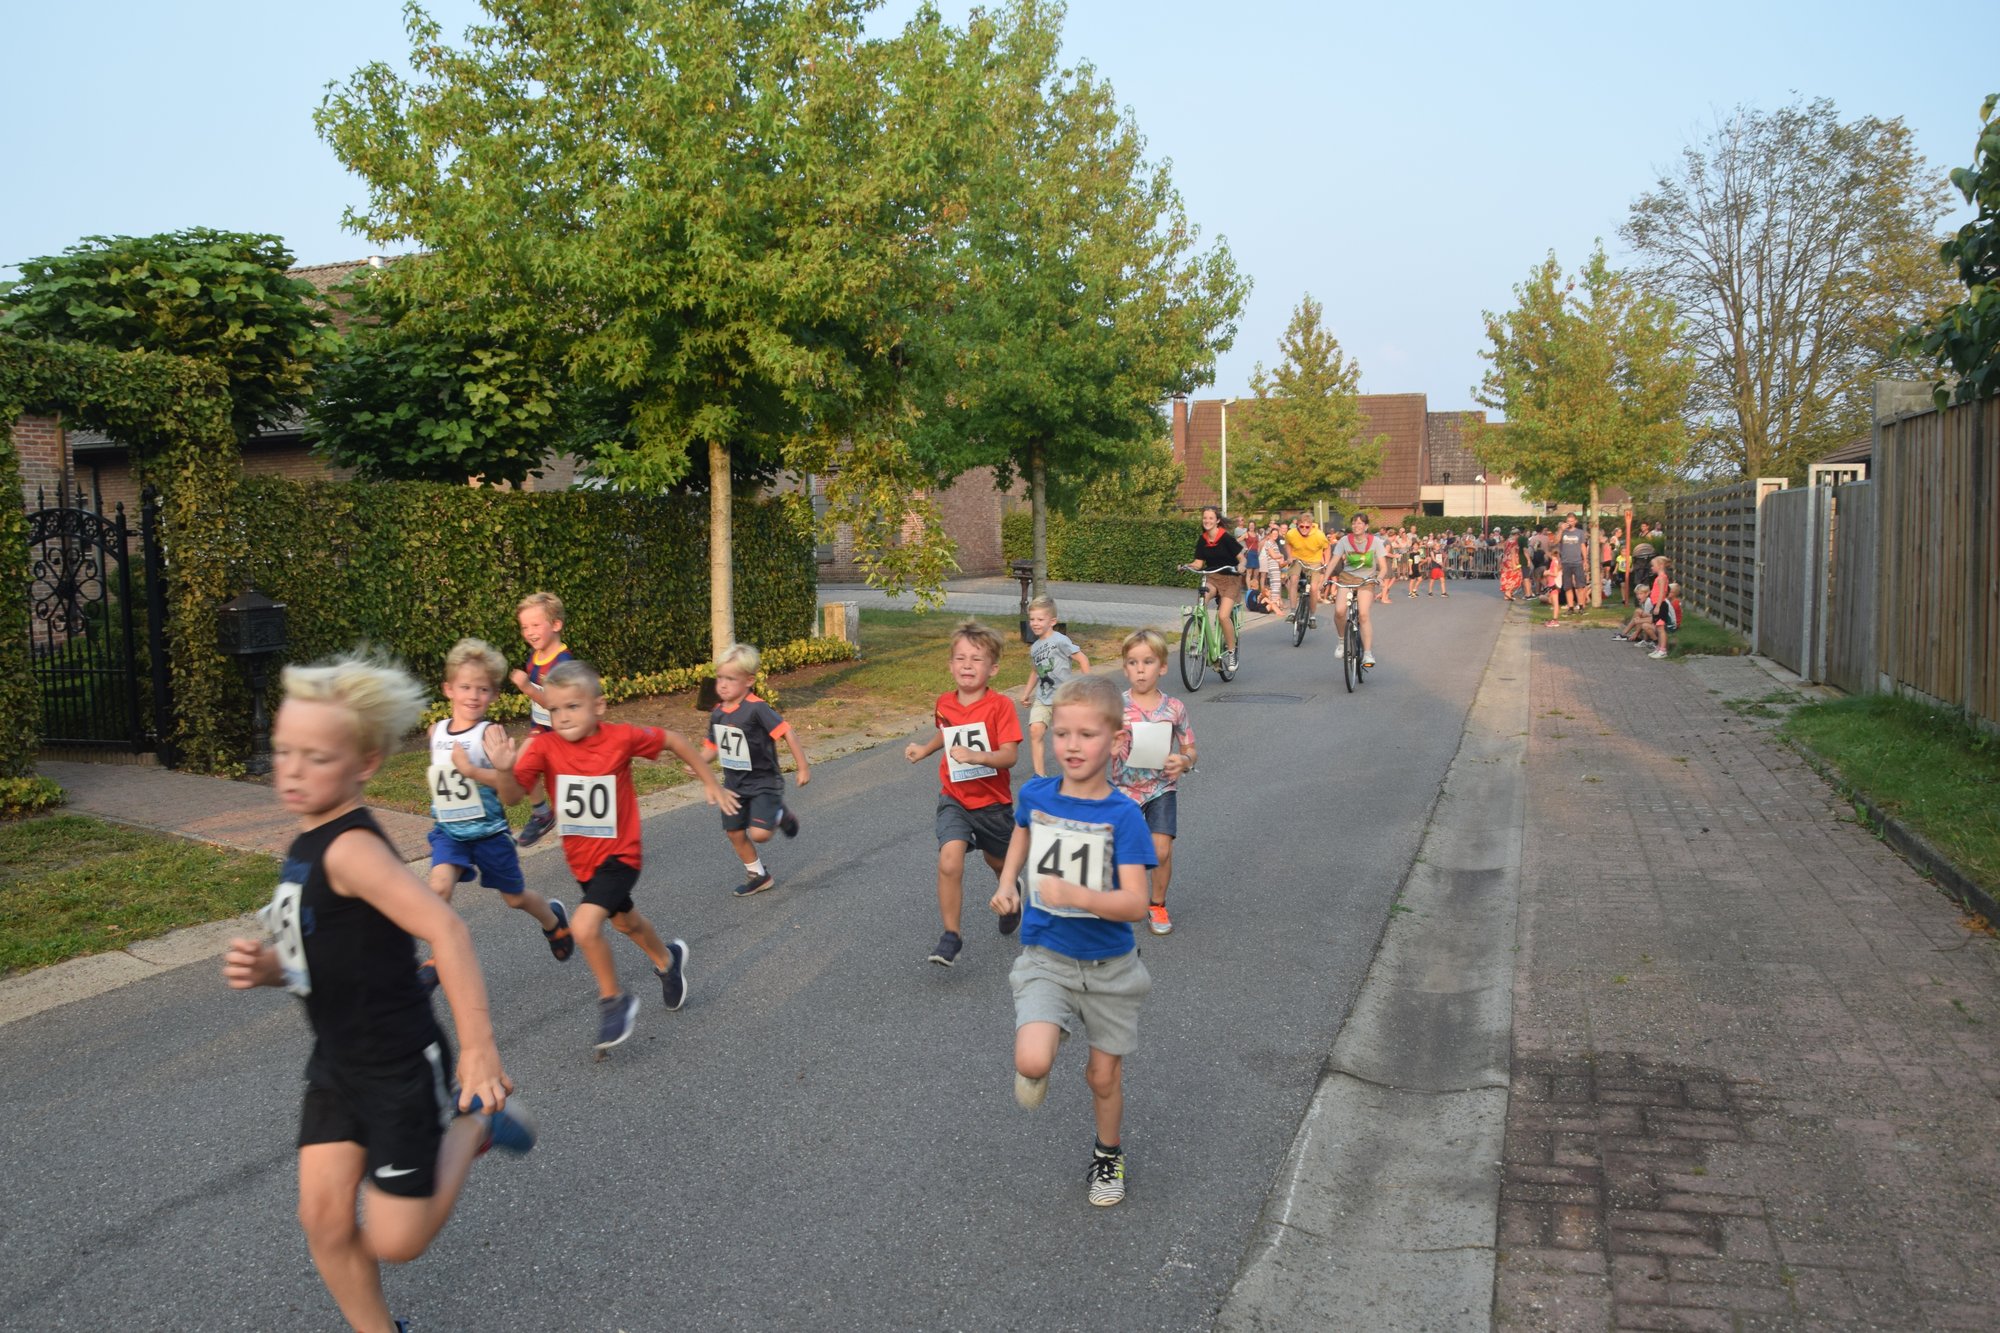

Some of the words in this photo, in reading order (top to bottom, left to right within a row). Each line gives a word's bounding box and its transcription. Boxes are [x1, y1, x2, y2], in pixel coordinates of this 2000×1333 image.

[720, 731, 743, 757] 47
[437, 769, 471, 801] 43
[564, 783, 610, 819] 50
[1037, 838, 1091, 888] 41
